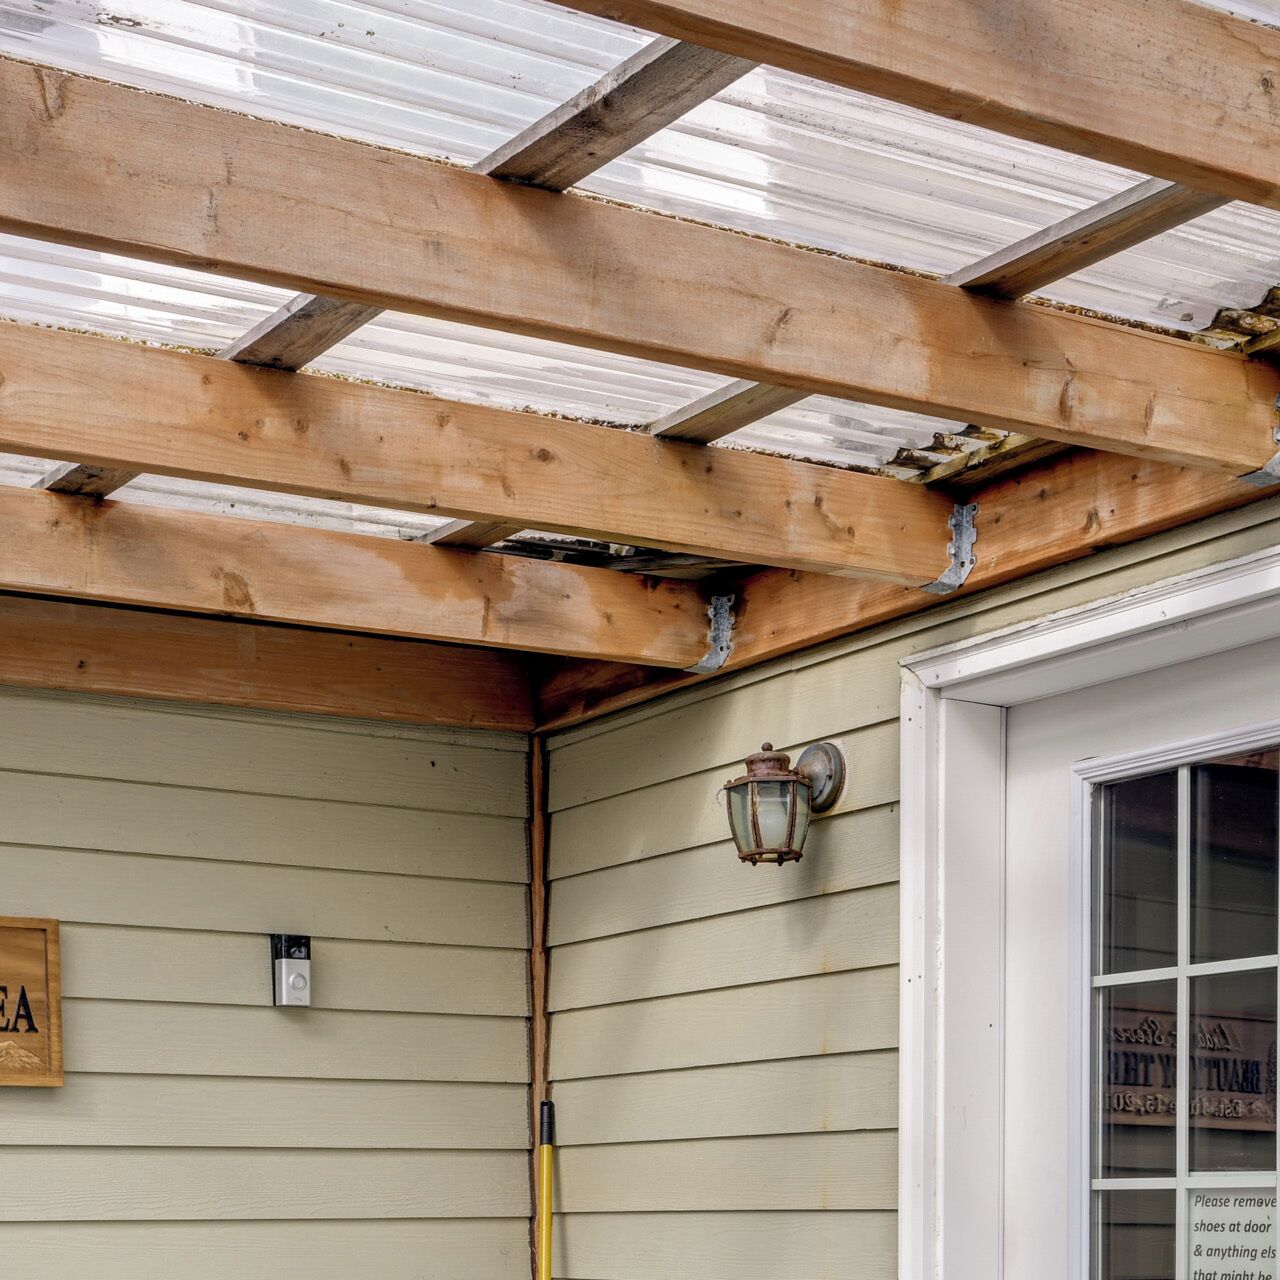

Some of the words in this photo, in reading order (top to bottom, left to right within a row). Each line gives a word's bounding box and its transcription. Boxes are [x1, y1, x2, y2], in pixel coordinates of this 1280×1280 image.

[1194, 1195, 1230, 1208] Please
[1233, 1196, 1277, 1208] remove
[1193, 1219, 1226, 1233] shoes
[1228, 1221, 1241, 1233] at
[1244, 1220, 1272, 1233] door
[1193, 1244, 1203, 1257] &
[1206, 1245, 1258, 1261] anything
[1261, 1245, 1277, 1259] els
